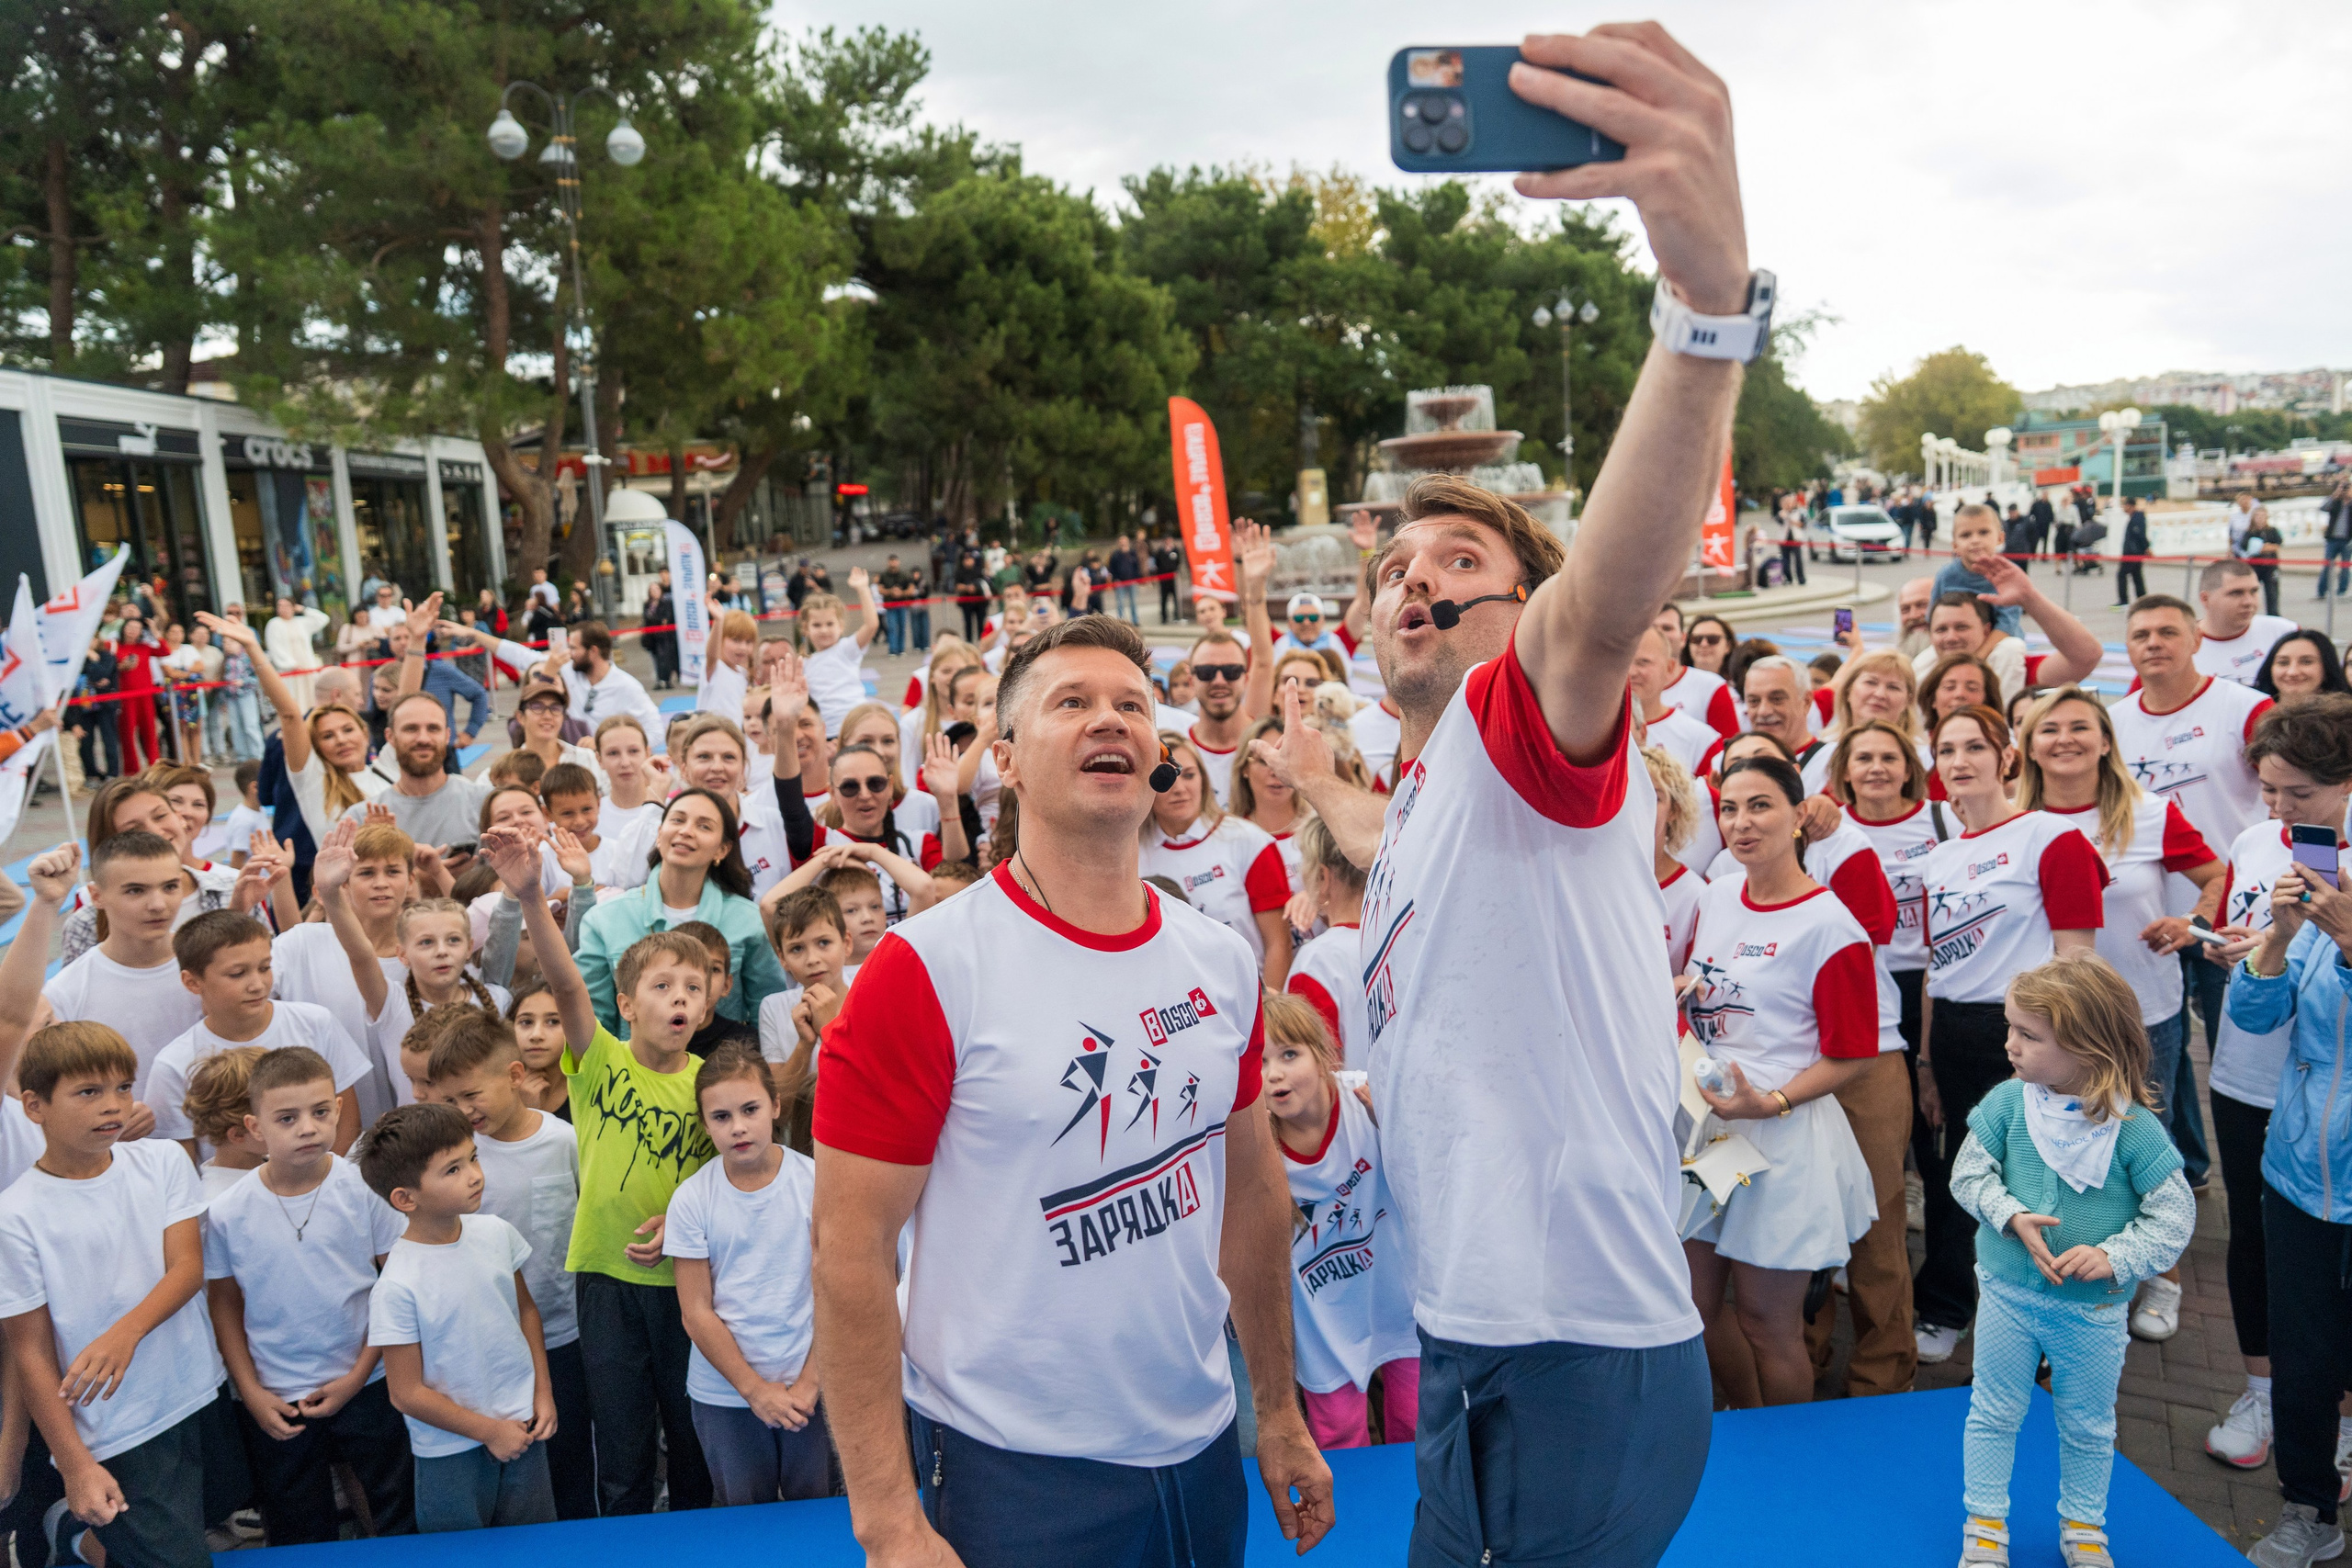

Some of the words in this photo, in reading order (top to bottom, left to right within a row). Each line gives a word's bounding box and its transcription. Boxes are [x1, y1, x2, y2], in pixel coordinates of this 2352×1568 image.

[243, 436, 314, 468] crocs
[1139, 1000, 1200, 1047] BOSCO
[1049, 1161, 1201, 1267] ЗАРЯДКА
